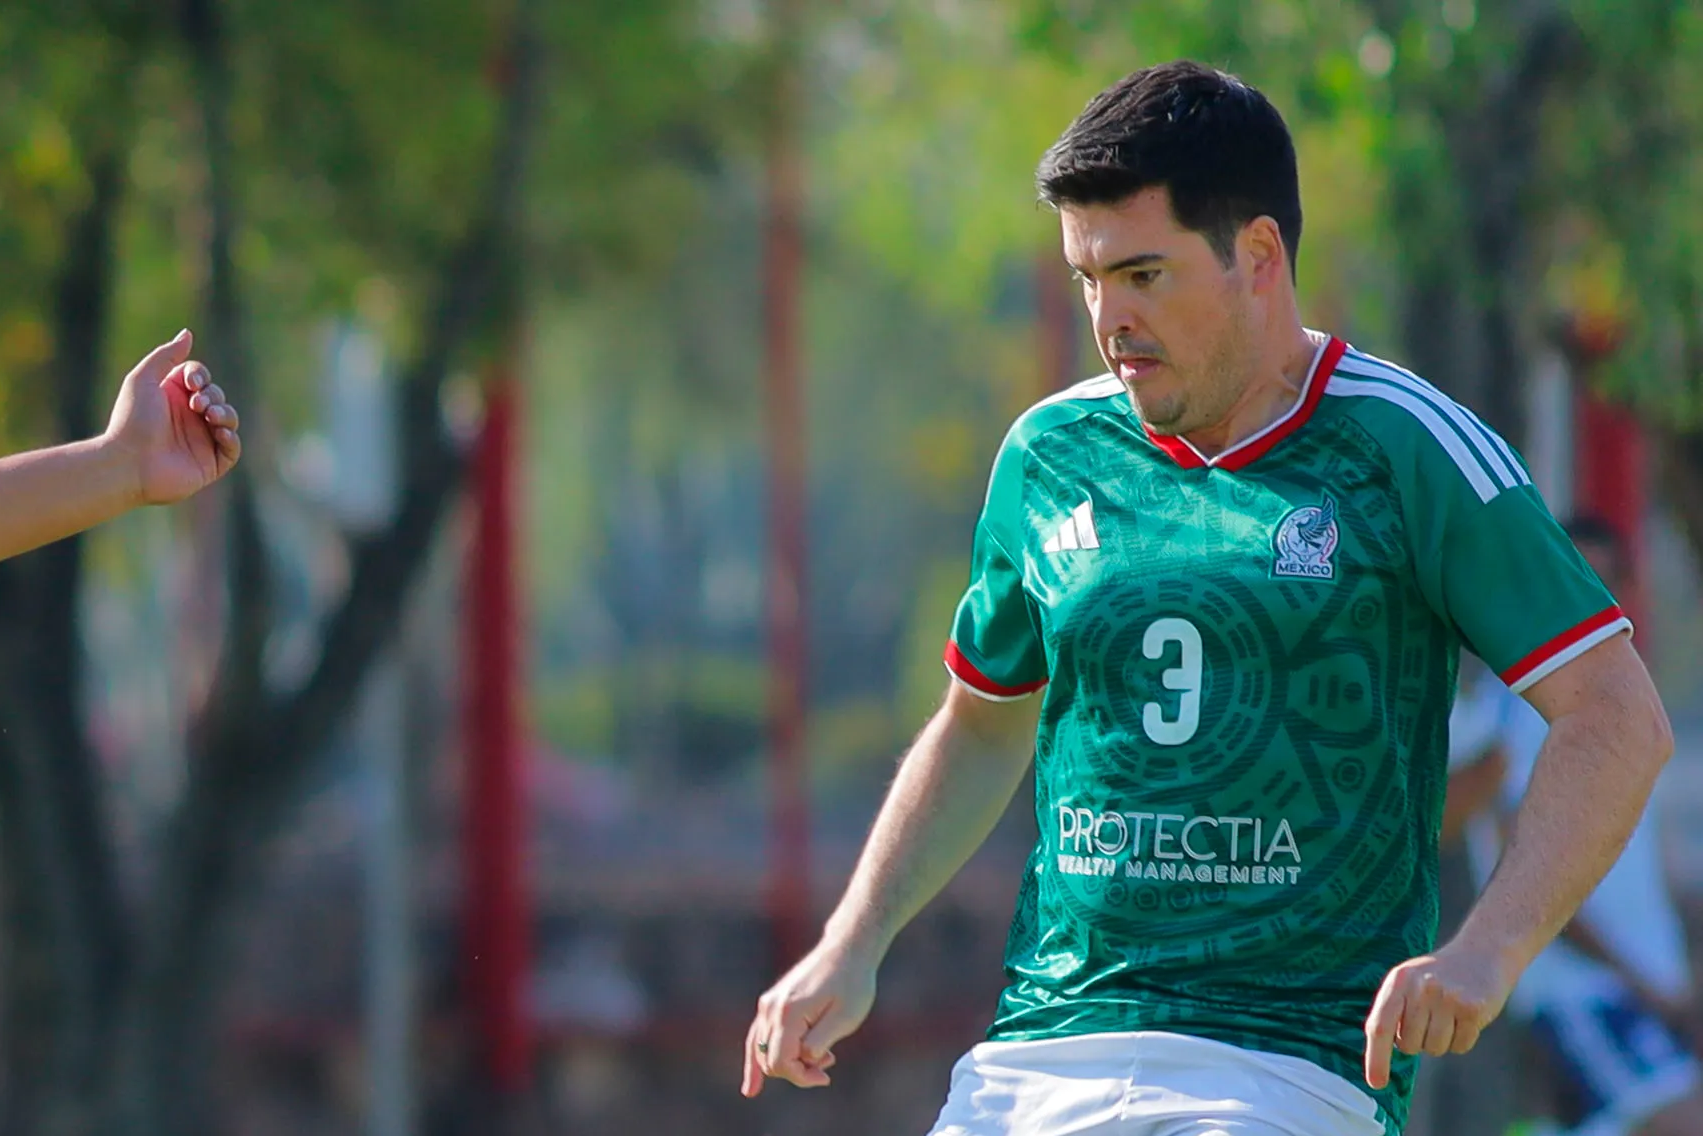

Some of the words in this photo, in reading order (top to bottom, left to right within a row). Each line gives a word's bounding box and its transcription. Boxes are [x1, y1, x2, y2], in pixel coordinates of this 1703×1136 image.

[1142, 617, 1203, 746] 3
[1059, 805, 1302, 863] PROTECTIA
[1057, 854, 1116, 877] WEALTH
[1125, 860, 1301, 885] MANAGEMENT
